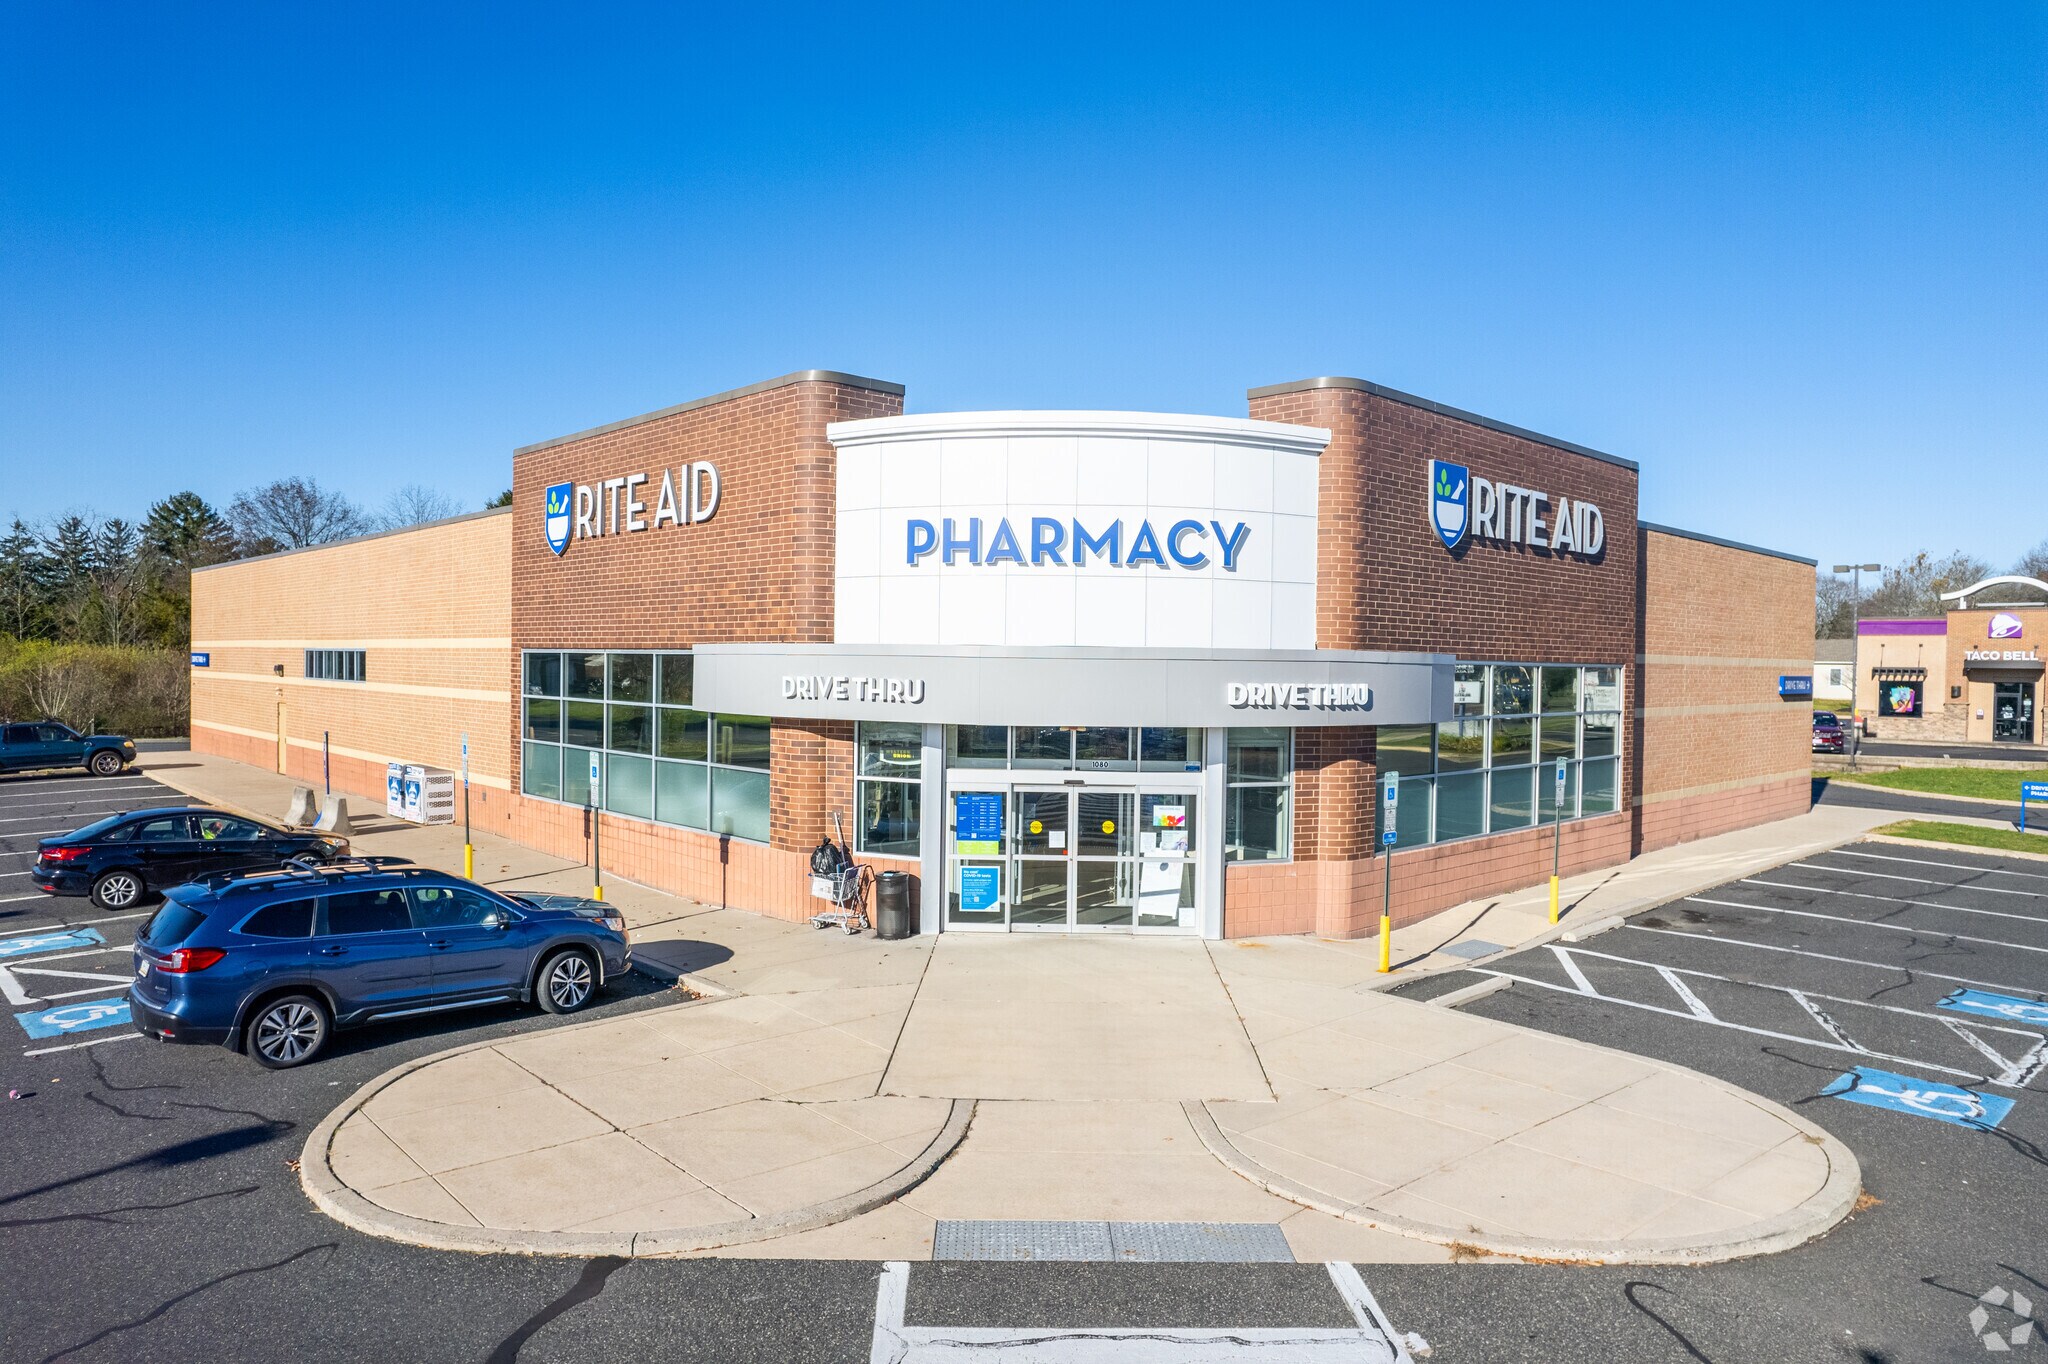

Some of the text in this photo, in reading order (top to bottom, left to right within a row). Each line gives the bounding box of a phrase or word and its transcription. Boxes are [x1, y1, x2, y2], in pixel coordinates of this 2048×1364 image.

[576, 460, 722, 540] RITE AID
[1471, 476, 1604, 555] RITE AID
[906, 516, 1249, 571] PHARMACY
[1965, 650, 2039, 661] TACO BELL
[782, 676, 925, 704] DRIVE THRU
[1228, 683, 1371, 710] DRIVE THRU
